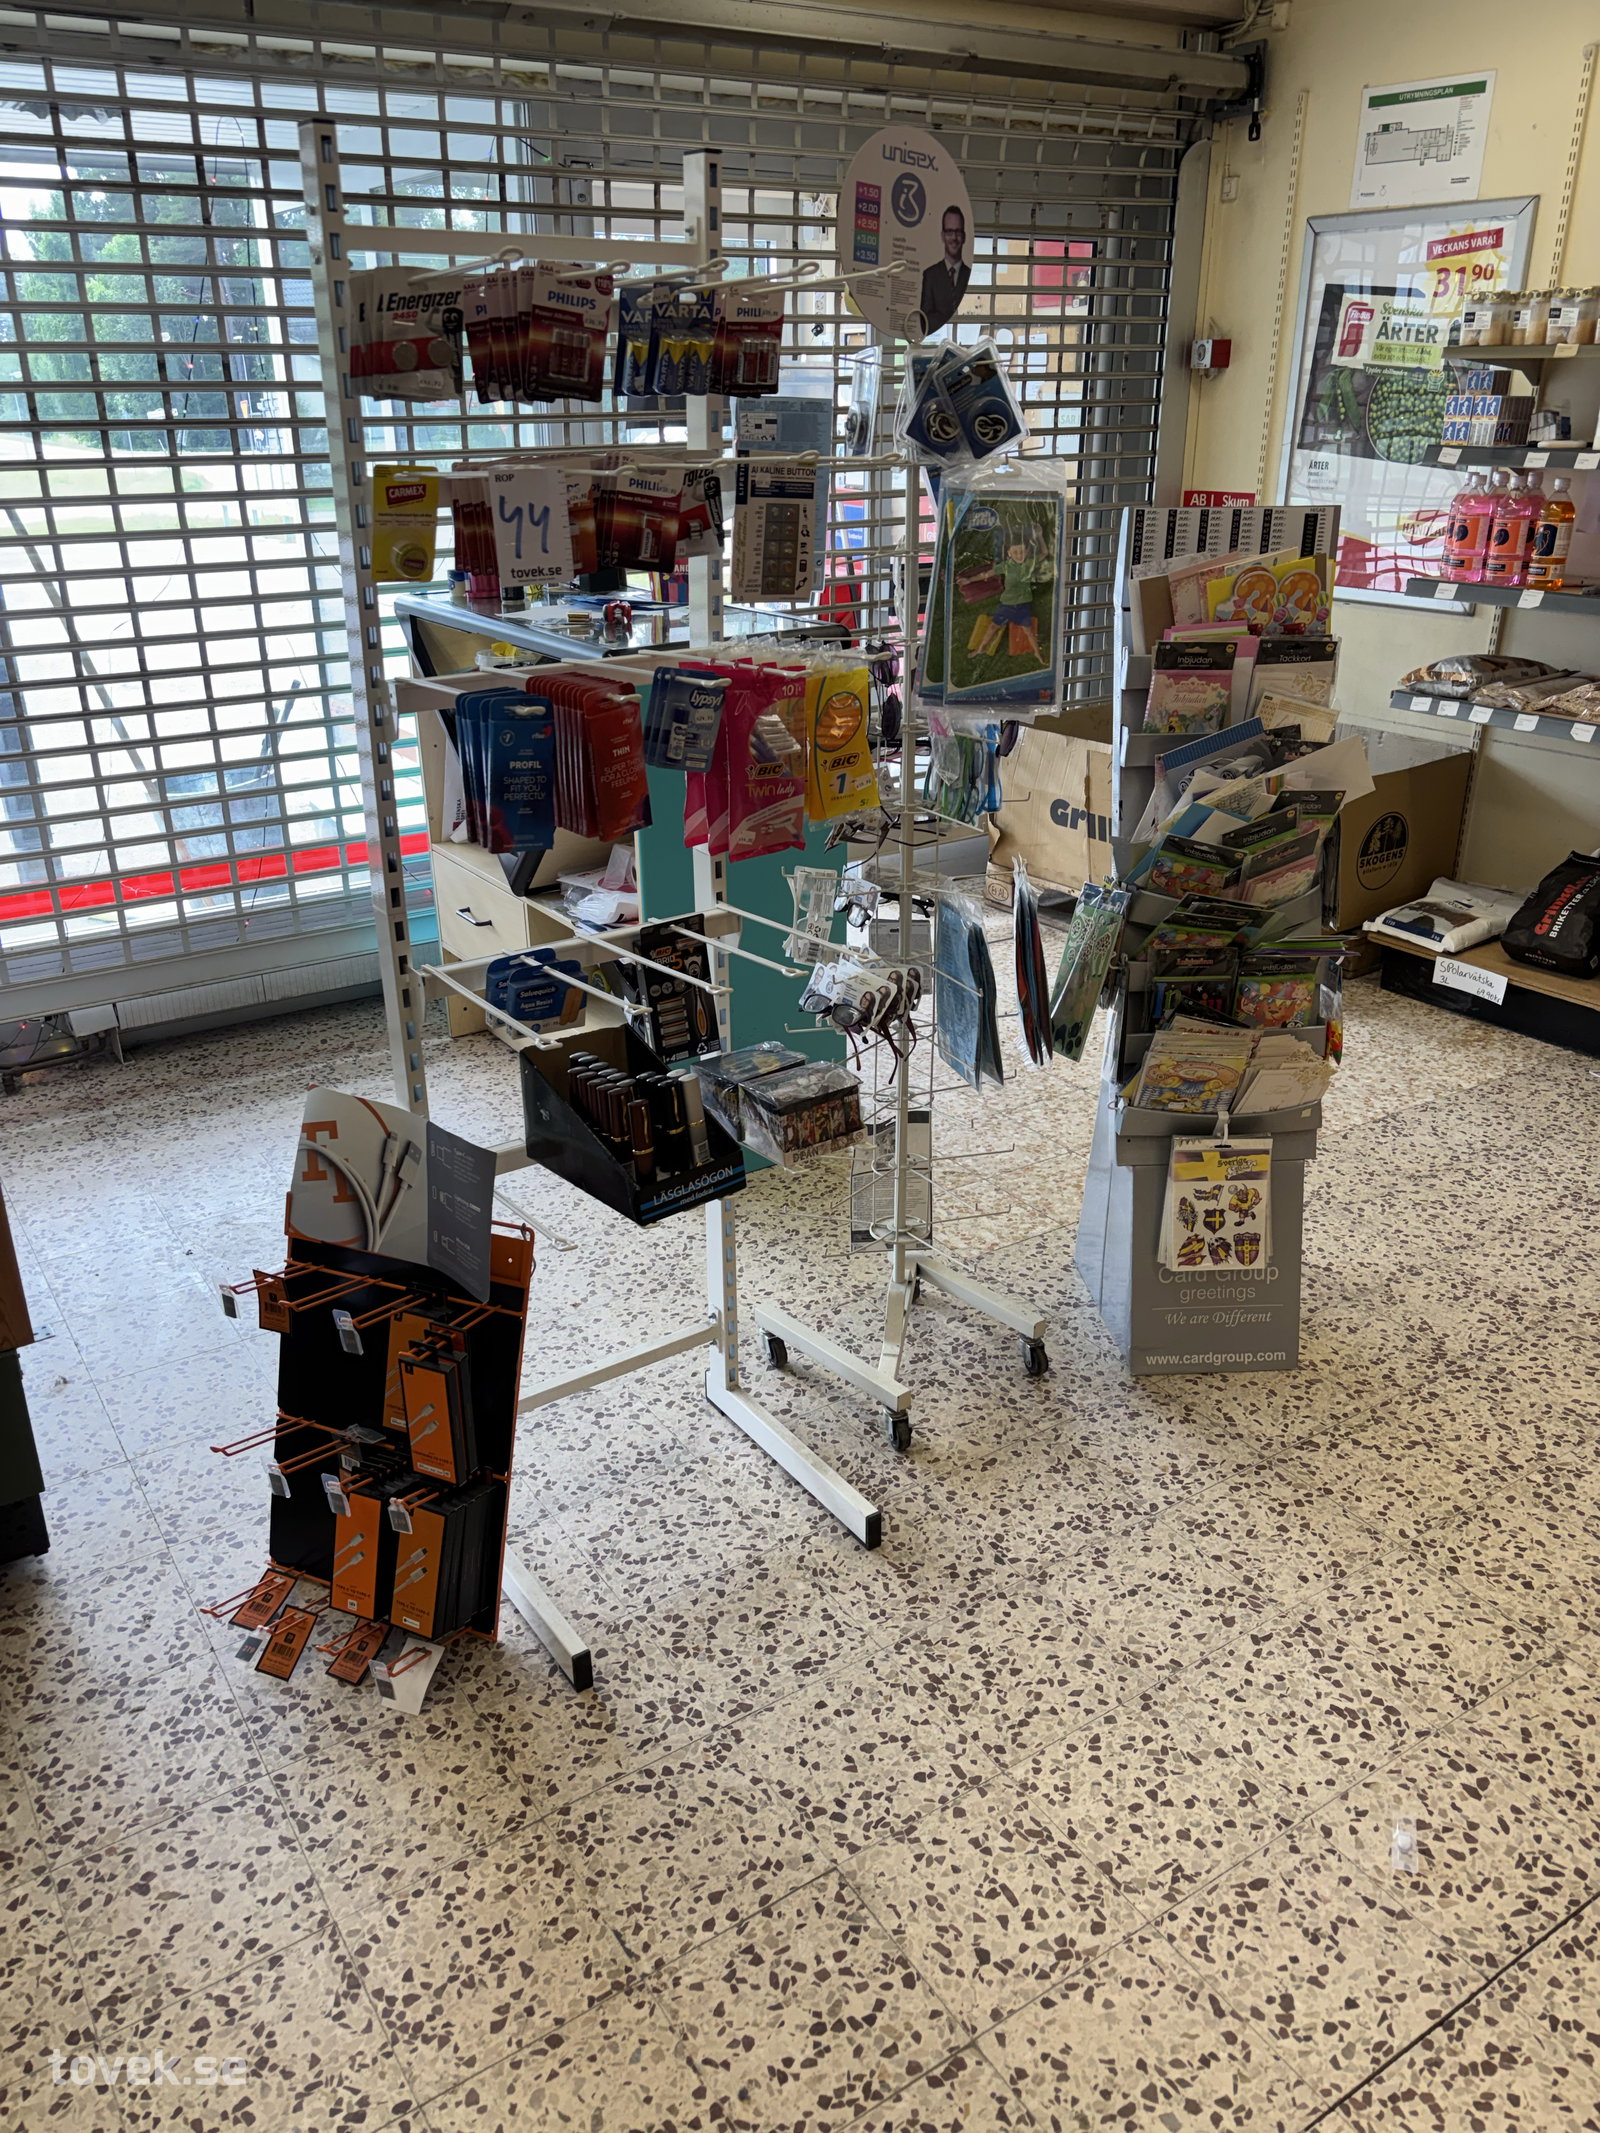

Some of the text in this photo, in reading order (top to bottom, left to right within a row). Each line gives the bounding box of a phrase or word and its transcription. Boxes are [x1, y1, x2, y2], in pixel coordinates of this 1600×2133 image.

[1399, 87, 1454, 100] UTRYMNINGSPLAN
[1432, 234, 1497, 255] VECKANS VARA!
[386, 291, 462, 313] Energizer
[547, 290, 597, 310] PHILIPS
[655, 304, 711, 319] VARTA
[1376, 317, 1439, 344] ÄRTER
[495, 474, 515, 483] ROP
[786, 467, 816, 477] BUTTON
[388, 485, 425, 499] CARMEX
[1190, 493, 1249, 508] AB Skum
[510, 565, 562, 579] tovek.se
[1177, 655, 1213, 665] Inbjudan
[690, 688, 724, 707] Lypsyl
[612, 746, 630, 757] THIN
[509, 760, 543, 770] PROFIL
[503, 776, 547, 785] SHAPED TO
[510, 784, 541, 792] FIT YOU
[503, 792, 546, 801] PERFECTLY
[745, 783, 776, 798] Twin
[1359, 849, 1404, 869] SKOGENS
[1549, 893, 1584, 938] BRIKETTER
[519, 986, 556, 999] Salvequick
[653, 1165, 734, 1206] LÄSGLASÖGON
[1180, 1285, 1256, 1303] greetings
[1165, 1310, 1272, 1328] We are Different
[1146, 1350, 1286, 1366] www.cardgroup.com
